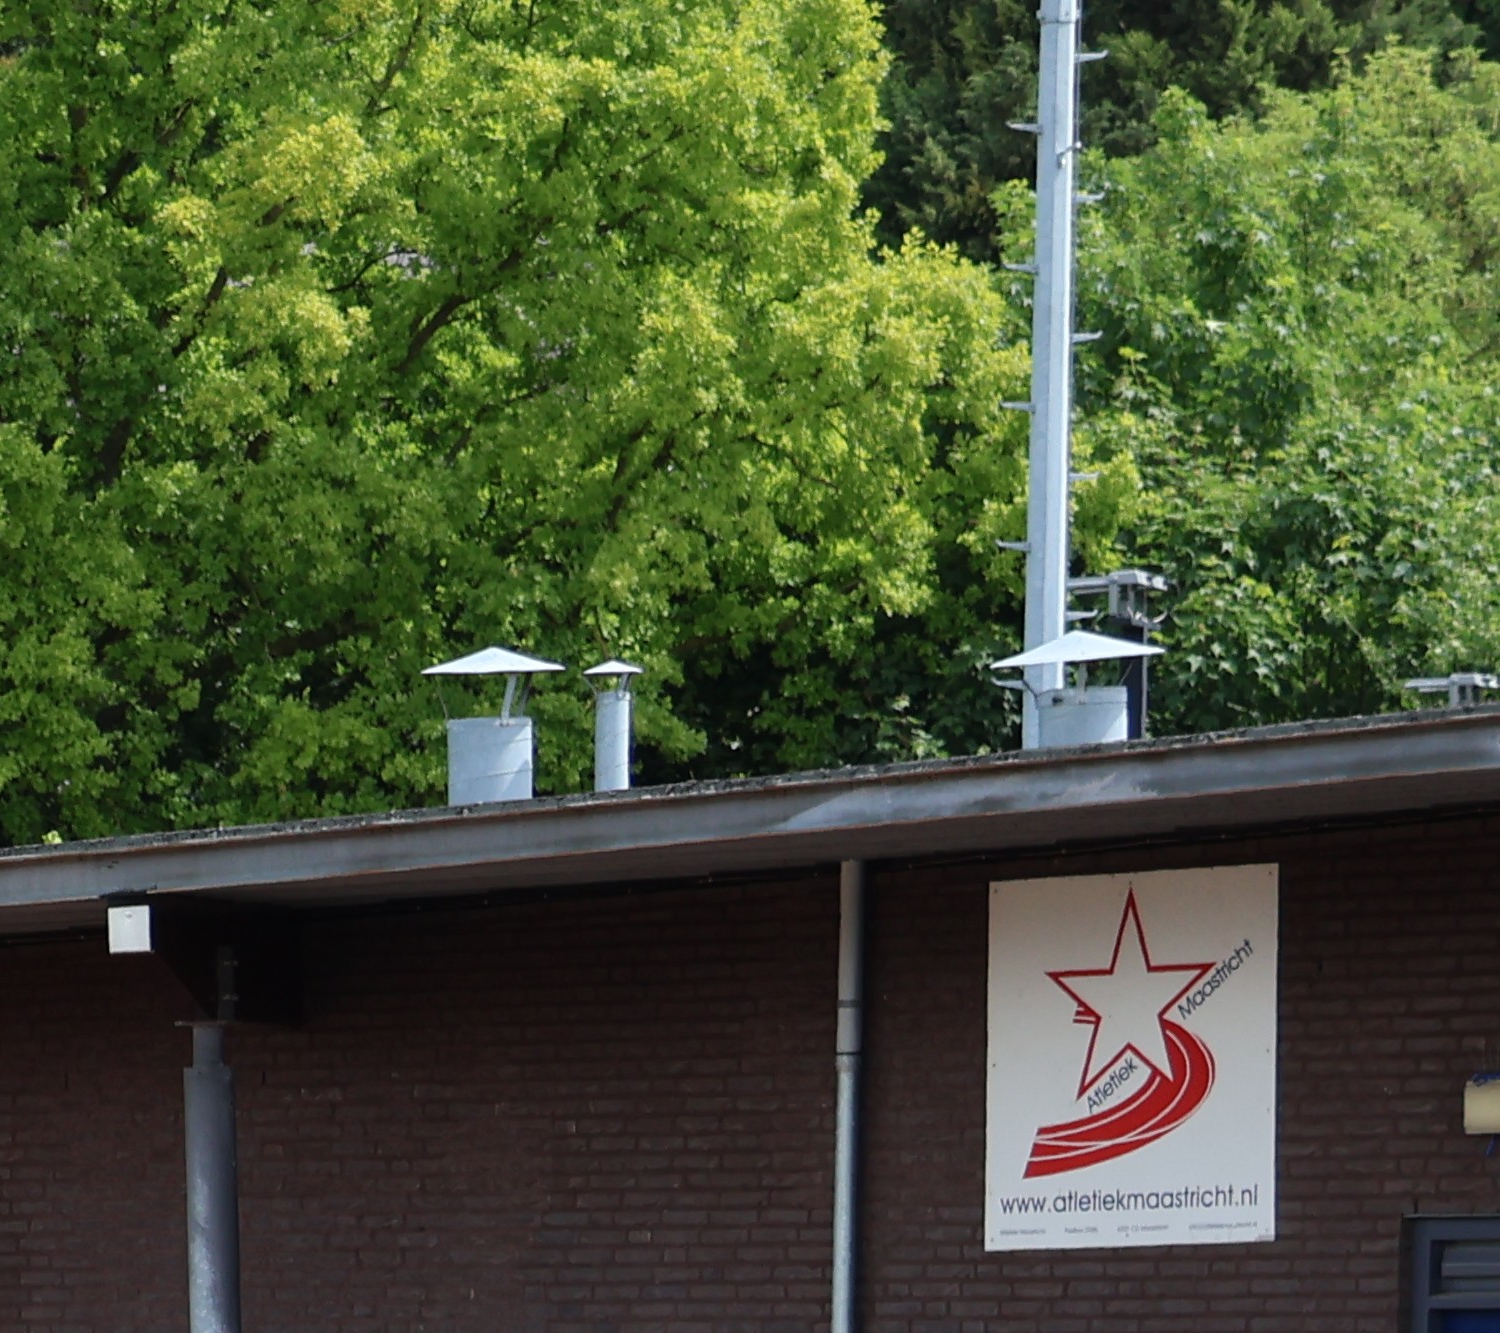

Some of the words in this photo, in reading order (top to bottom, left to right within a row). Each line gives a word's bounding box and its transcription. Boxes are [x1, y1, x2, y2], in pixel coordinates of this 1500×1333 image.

[1177, 938, 1254, 1020] Maastricht
[1086, 1057, 1139, 1114] Atletiek
[999, 1184, 1259, 1214] www.atletiekmaastricht.nl
